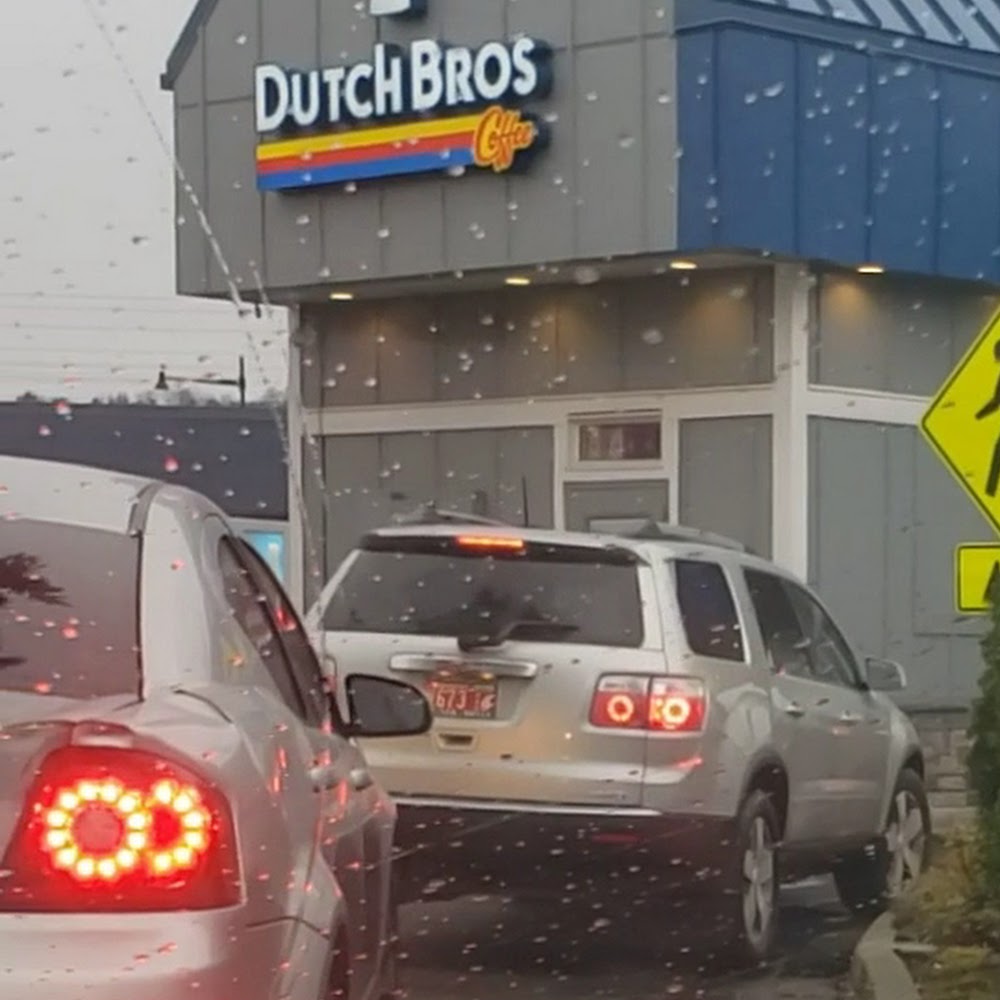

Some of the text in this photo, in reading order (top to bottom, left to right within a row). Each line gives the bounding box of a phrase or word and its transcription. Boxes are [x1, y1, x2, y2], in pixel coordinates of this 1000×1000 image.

[256, 37, 538, 132] DUTCH BROS
[474, 106, 534, 171] Coffee
